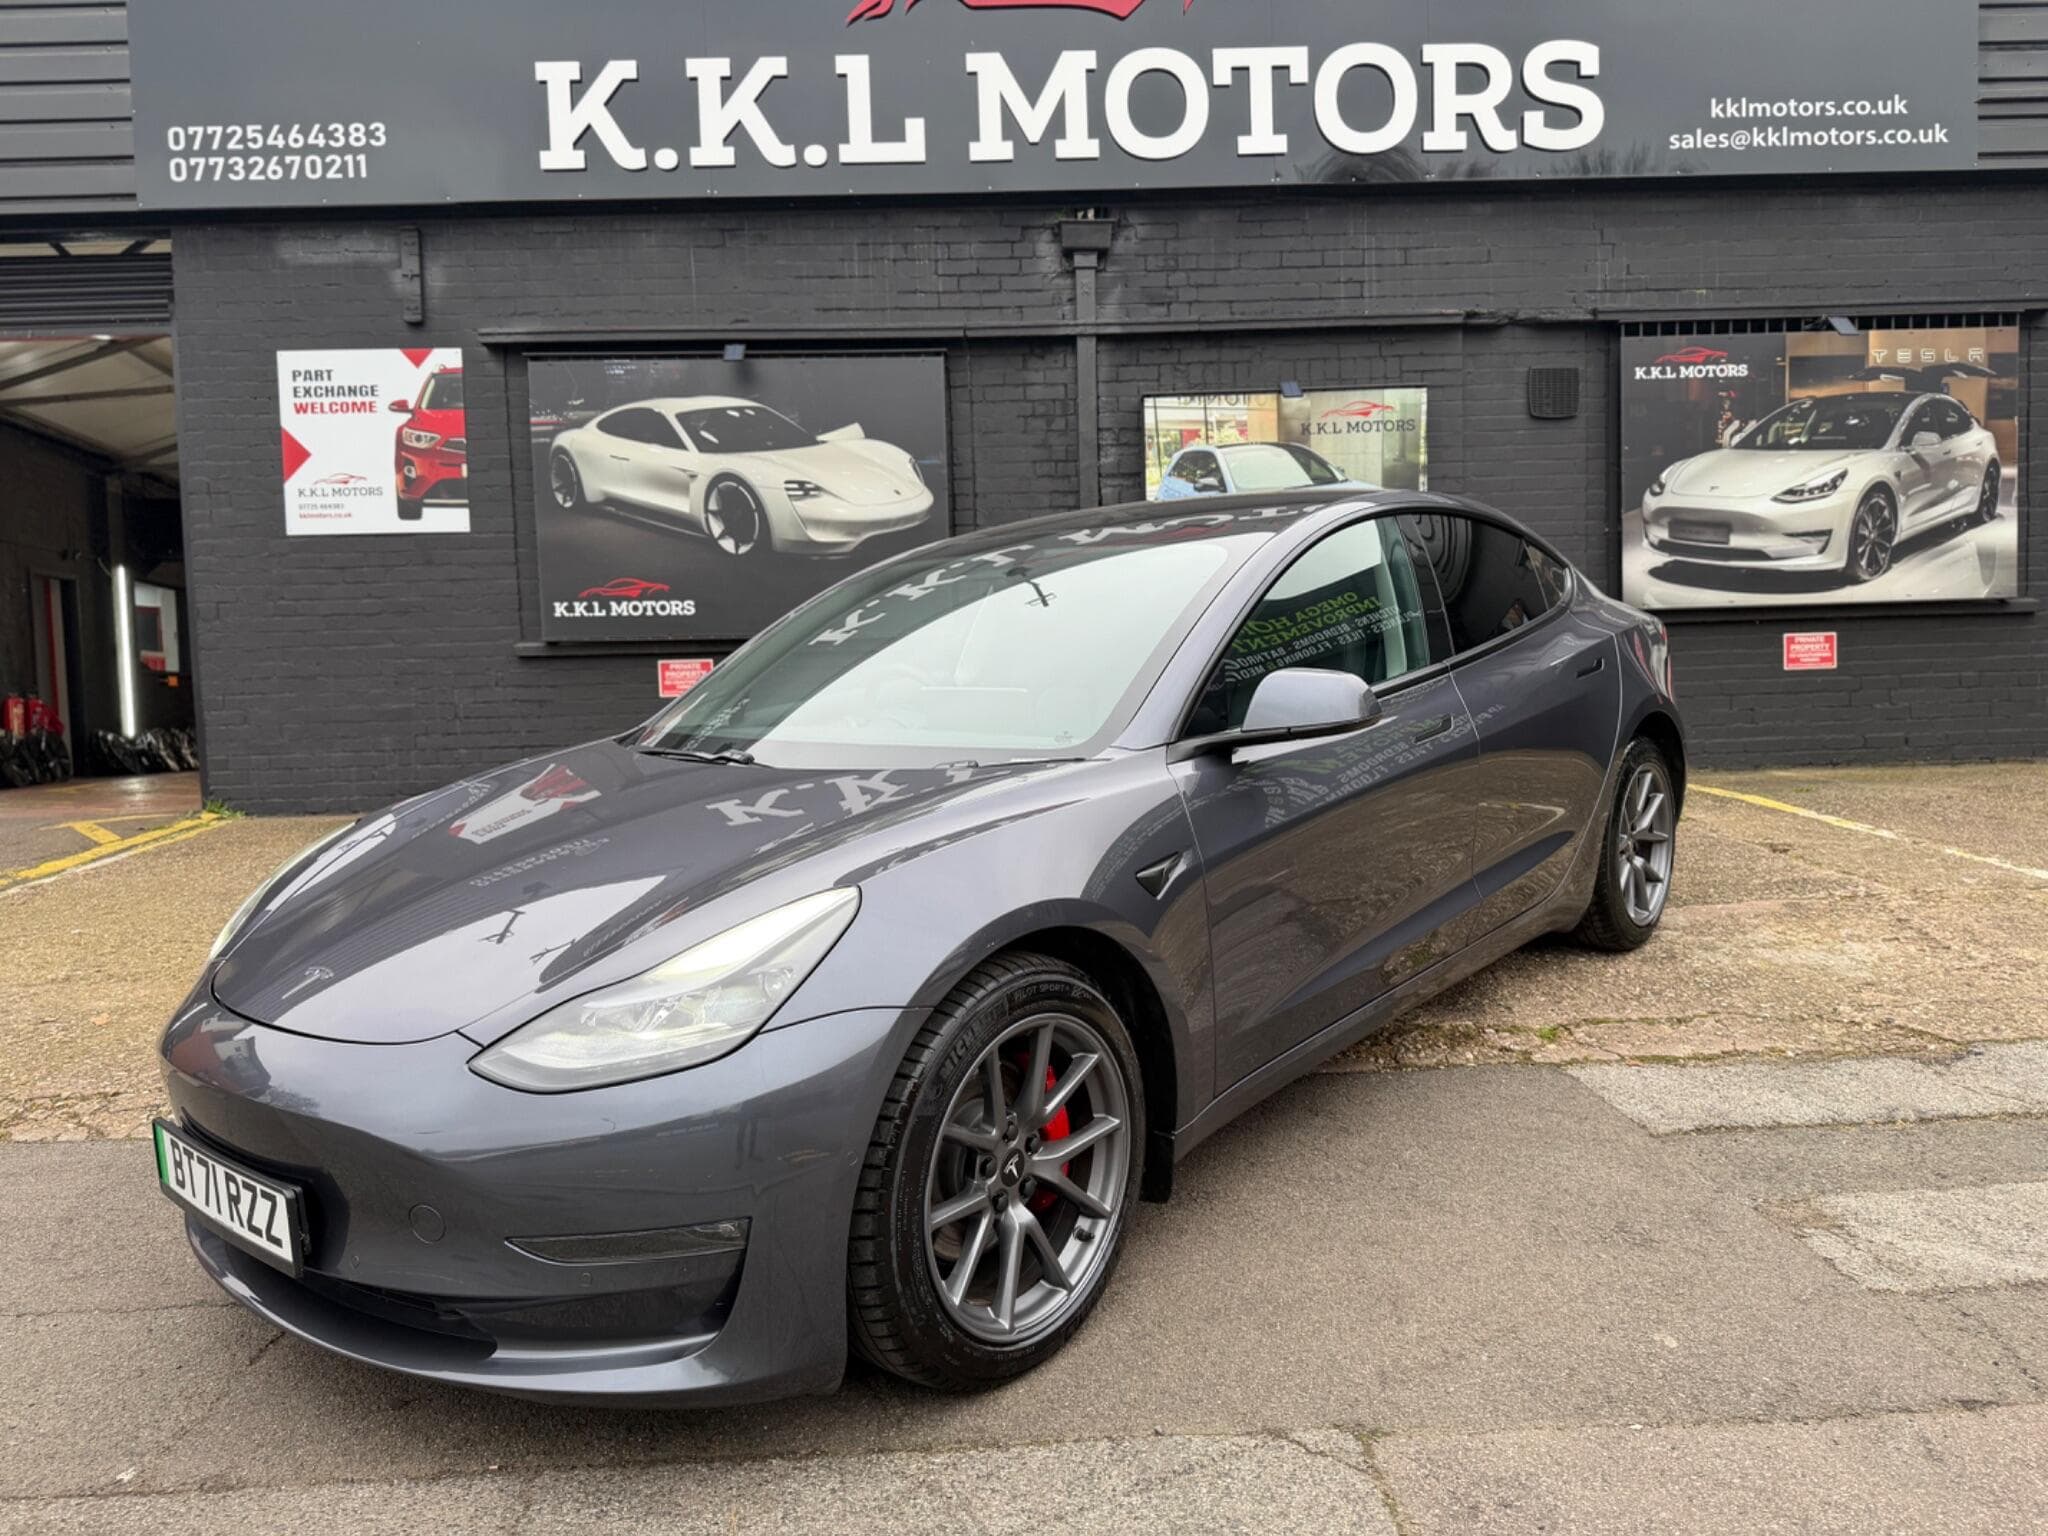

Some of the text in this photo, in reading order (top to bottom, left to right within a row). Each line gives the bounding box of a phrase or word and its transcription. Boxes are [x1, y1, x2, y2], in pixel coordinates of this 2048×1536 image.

[534, 39, 1605, 172] K.K.L MOTORS
[1709, 95, 1909, 121] kklmotors.co.uk
[166, 122, 388, 153] 07725464383
[1668, 124, 1950, 151] sales@kklmotors.co.uk
[168, 153, 369, 183] 07732670211
[1871, 347, 1985, 364] TESLA
[291, 369, 334, 382] PART
[1634, 363, 1749, 380] K.K.L MOTORS
[292, 384, 379, 398] EXCHANGE
[293, 401, 378, 415] WELCOME
[1300, 418, 1417, 436] K.K.L MOTORS
[331, 486, 384, 497] MOTORS
[553, 600, 697, 617] K.K.L MOTORS
